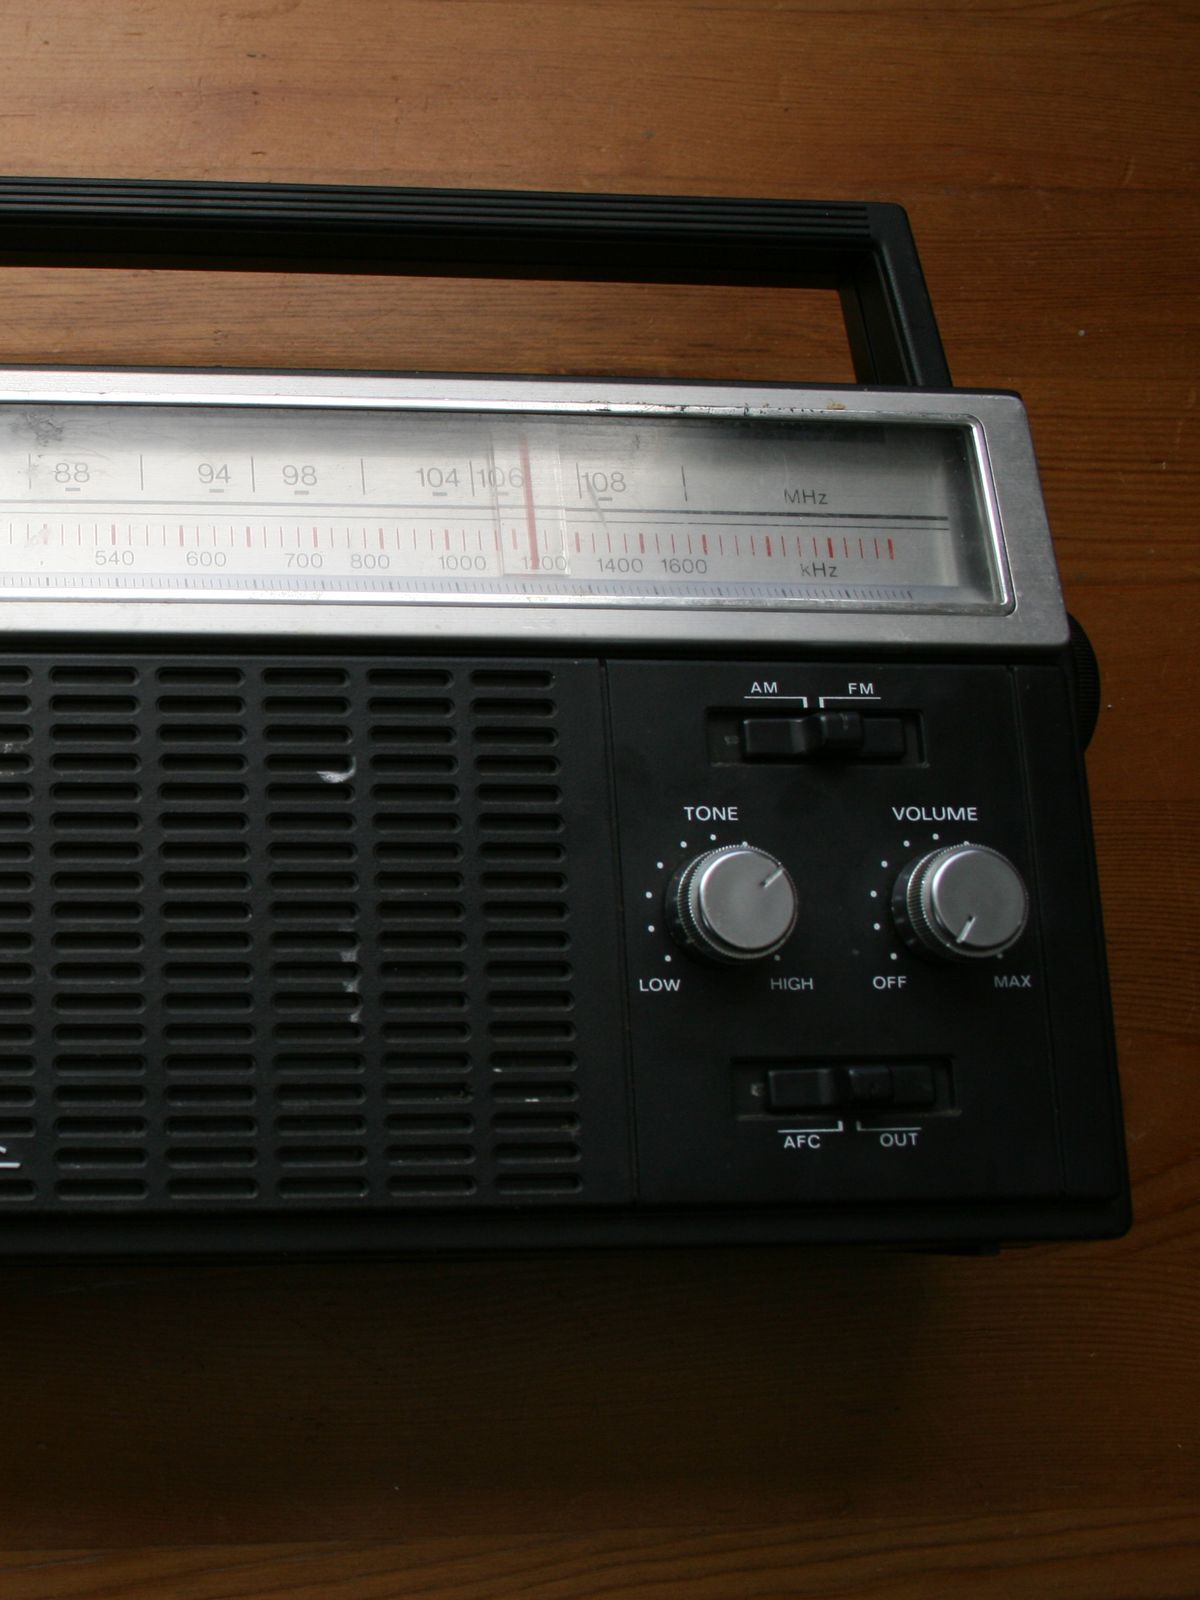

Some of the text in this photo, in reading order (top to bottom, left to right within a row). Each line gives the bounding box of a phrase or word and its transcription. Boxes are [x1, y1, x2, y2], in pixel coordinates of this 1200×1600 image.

[54, 461, 90, 484] 88
[197, 462, 231, 485] 94
[281, 464, 318, 487] 98
[416, 466, 460, 488] 104
[477, 466, 525, 488] 106
[581, 471, 626, 493] 108
[783, 488, 828, 506] MHz
[95, 549, 135, 567] 540
[186, 551, 227, 568] 600
[284, 552, 324, 569] 700
[350, 553, 391, 570] 800
[438, 554, 487, 571] 1000
[522, 555, 567, 571] 100
[597, 557, 643, 574] 1400
[661, 557, 708, 575] 1600
[800, 561, 838, 578] kHz
[750, 681, 778, 695] AM
[848, 683, 874, 696] FM
[683, 806, 739, 822] TONE
[891, 806, 978, 822] VOLUME
[639, 978, 680, 992] LOW
[770, 977, 814, 991] HIGH
[872, 976, 907, 990] OFF
[994, 974, 1031, 988] MAX
[783, 1134, 821, 1149] AFC
[880, 1132, 919, 1147] OUT
